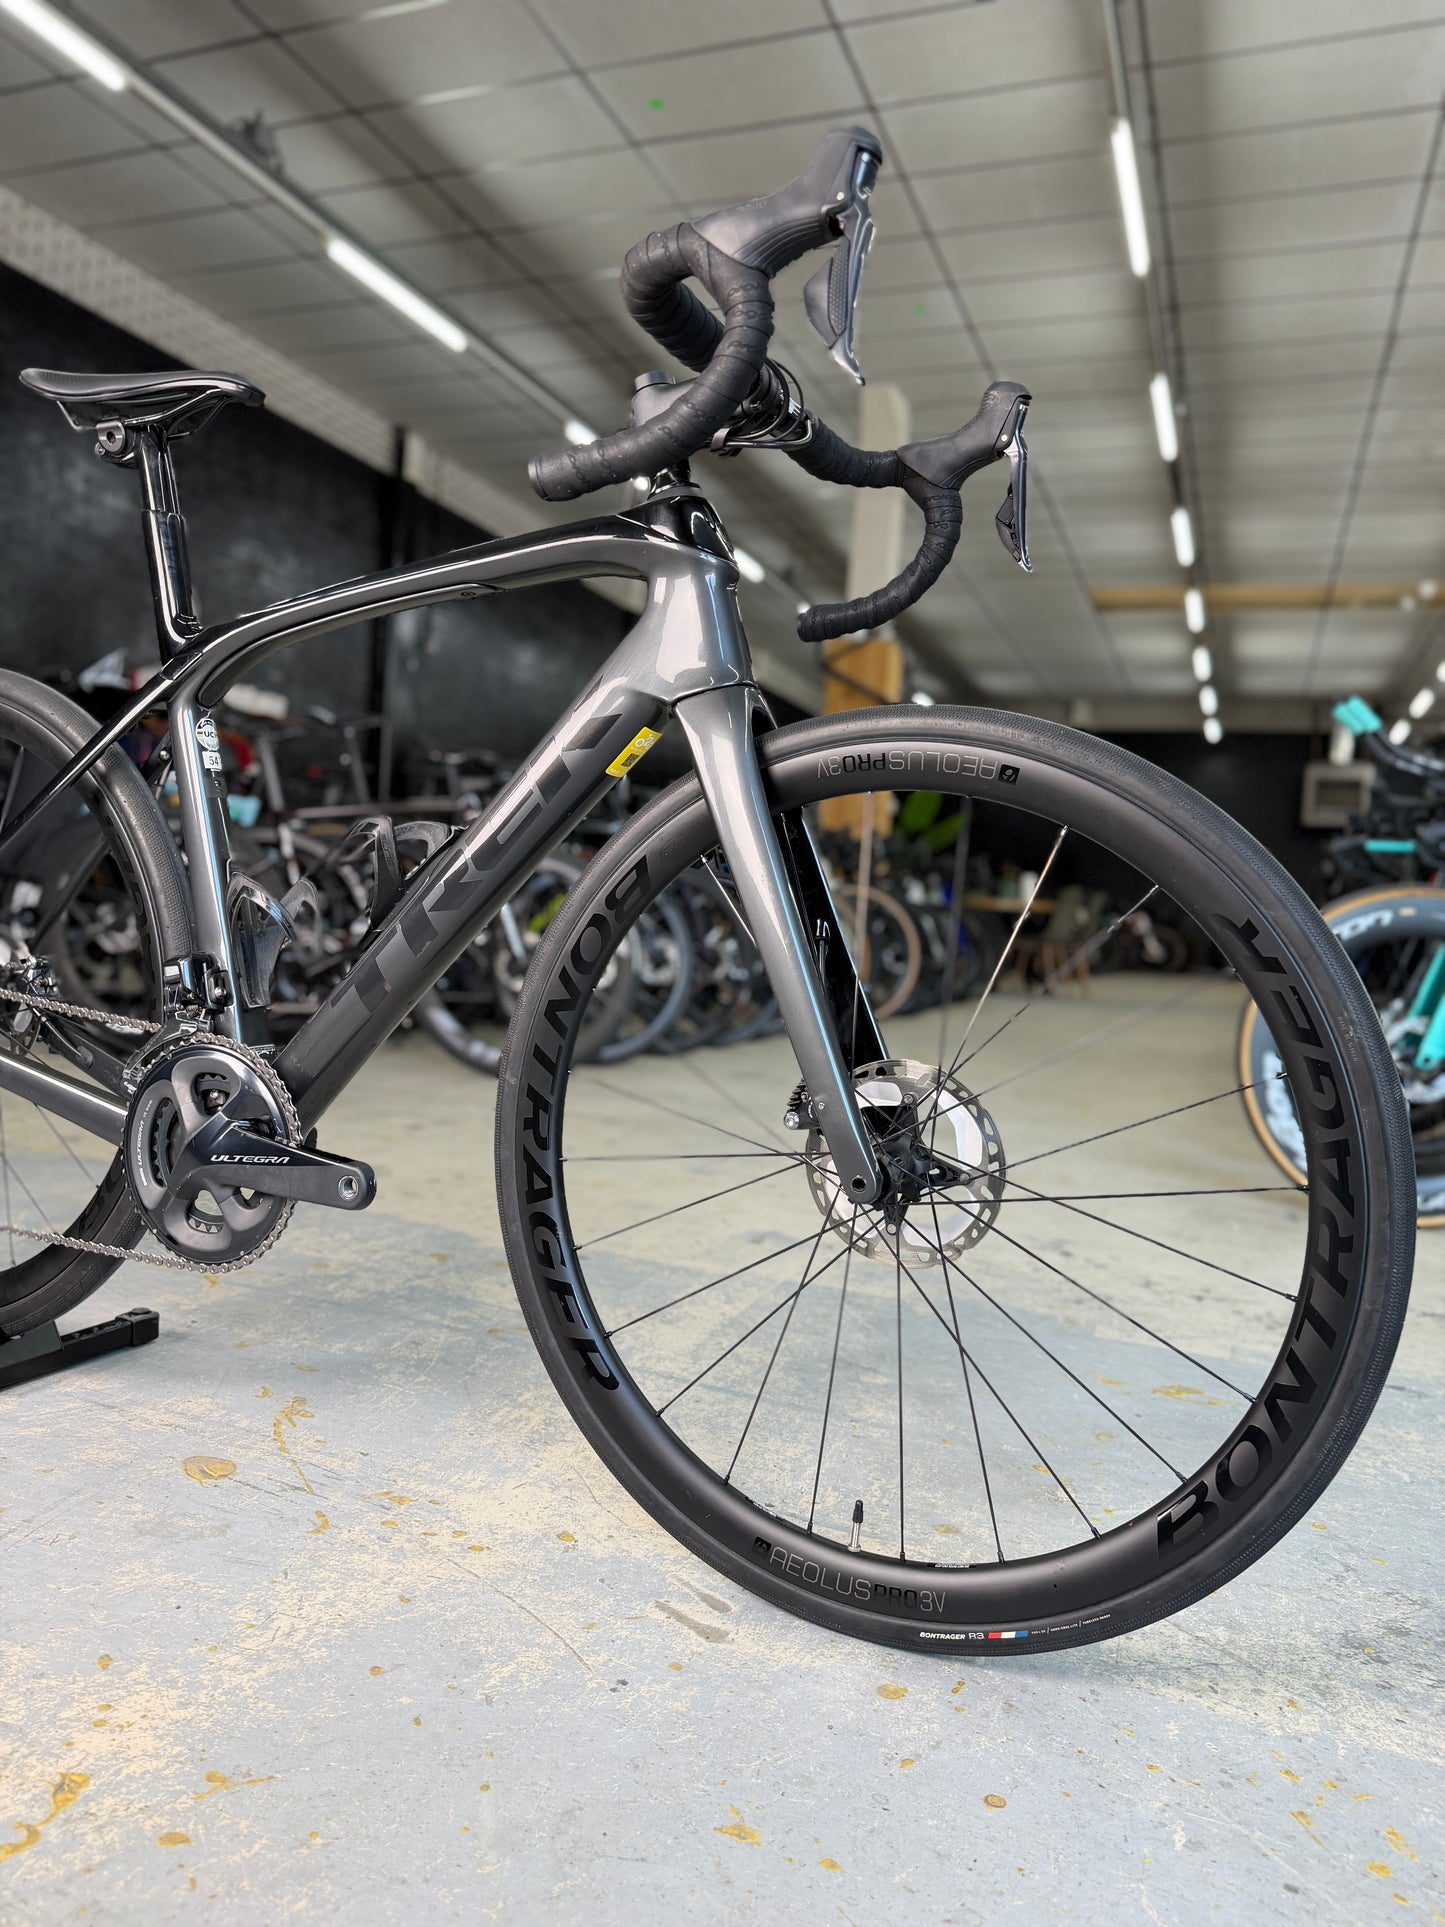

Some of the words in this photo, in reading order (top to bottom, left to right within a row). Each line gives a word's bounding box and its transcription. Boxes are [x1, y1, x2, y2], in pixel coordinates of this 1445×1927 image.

[331, 674, 623, 1015] TREK
[210, 1154, 290, 1164] ULTEGRA
[919, 1631, 966, 1640] BONTRAGER
[968, 1632, 985, 1640] R3
